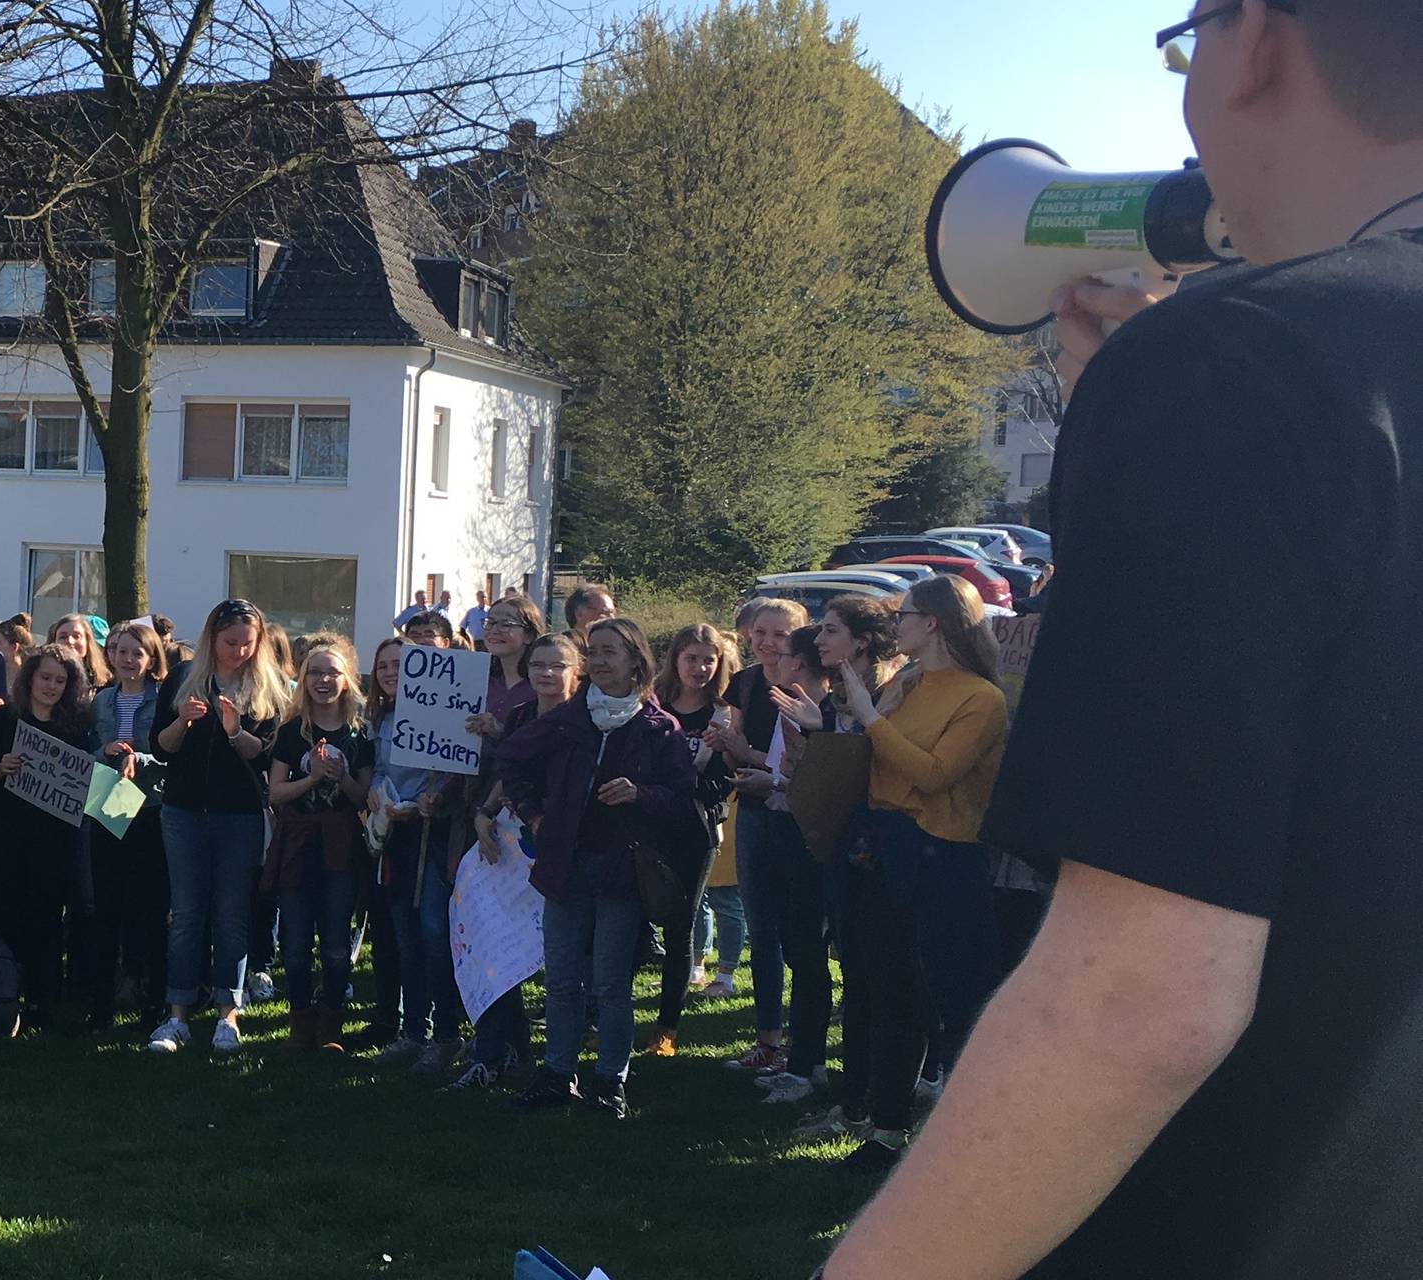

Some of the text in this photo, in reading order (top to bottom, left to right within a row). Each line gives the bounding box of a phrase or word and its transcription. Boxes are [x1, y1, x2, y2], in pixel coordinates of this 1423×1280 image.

[404, 648, 461, 687] OPA,
[445, 693, 482, 714] sind
[17, 726, 91, 775] MARCH NOW
[392, 719, 479, 768] Eisbären
[39, 761, 56, 778] OR
[41, 783, 83, 816] LATER
